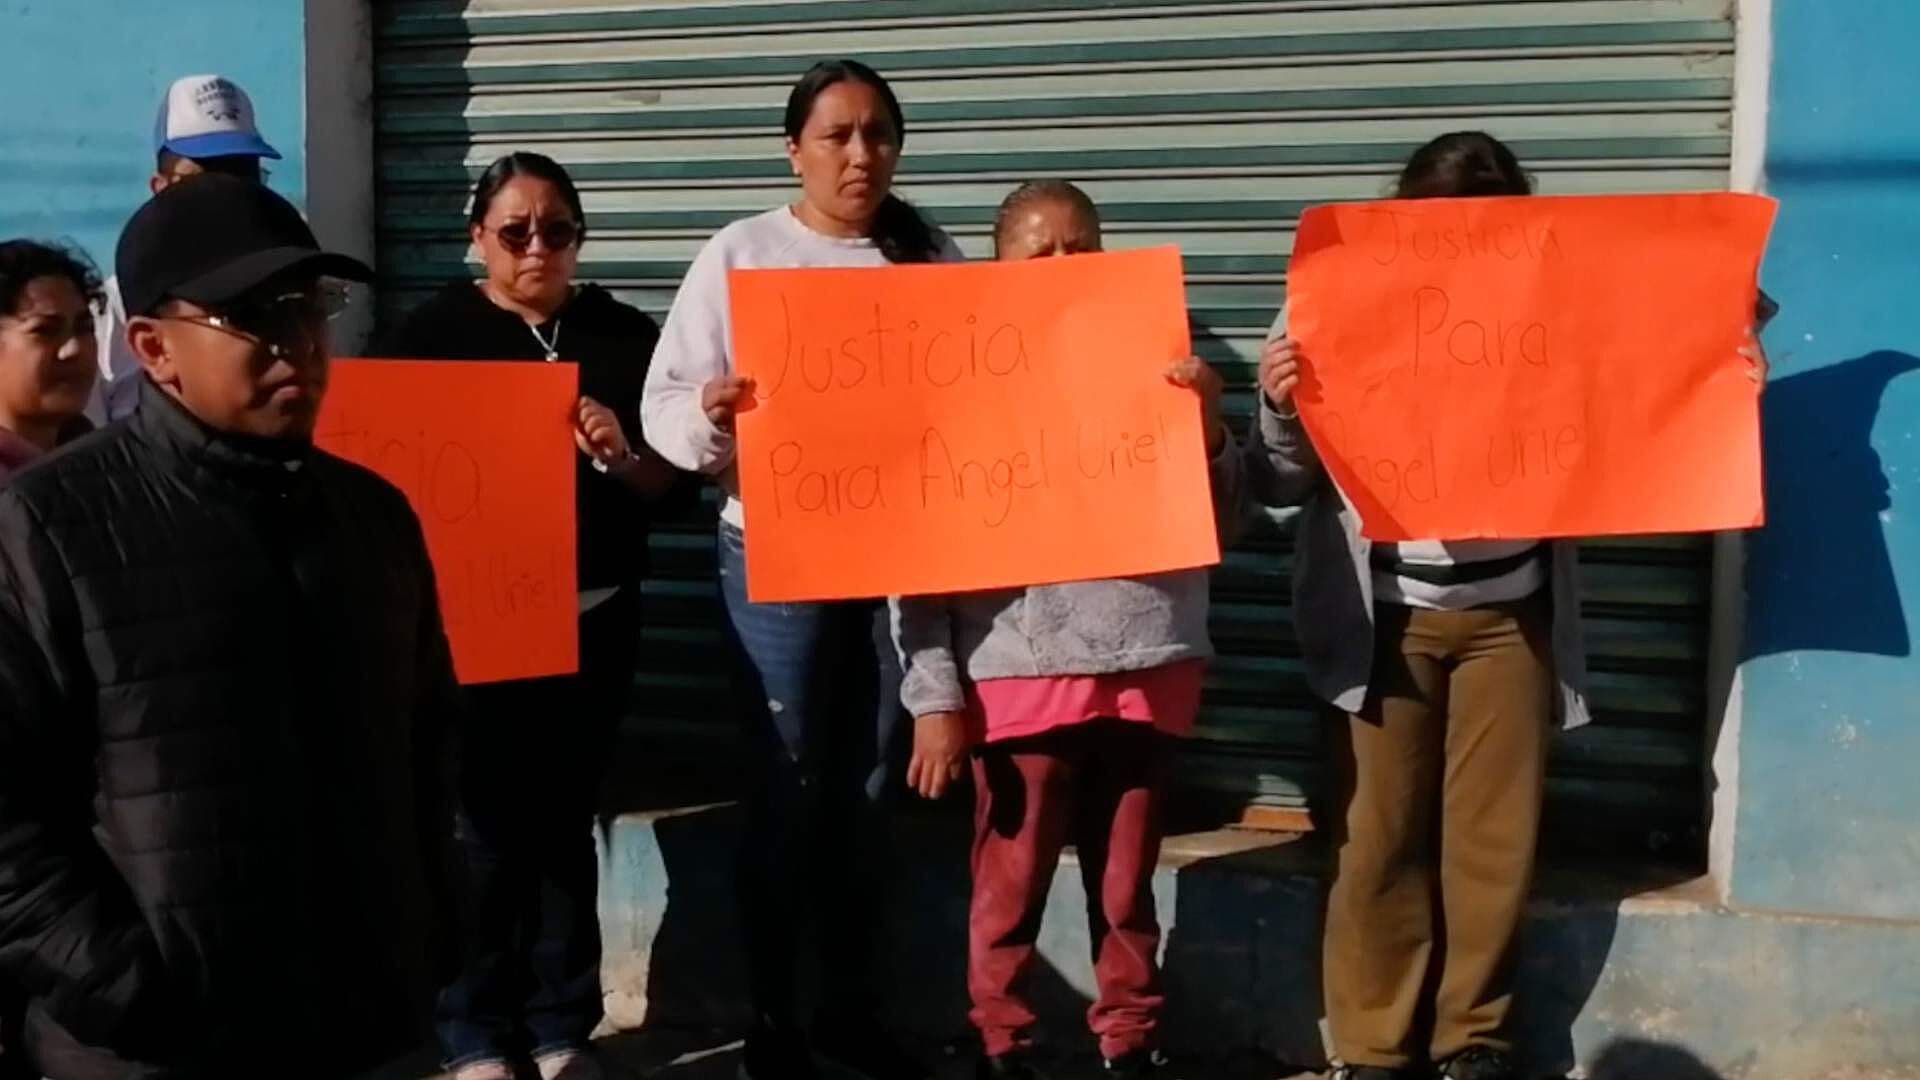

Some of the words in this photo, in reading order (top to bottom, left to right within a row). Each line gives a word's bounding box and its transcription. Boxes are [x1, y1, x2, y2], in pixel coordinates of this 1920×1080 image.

[753, 294, 1030, 400] Justicia
[1412, 285, 1549, 376] Para
[769, 441, 886, 518] Para
[919, 427, 1051, 528] Angel
[1078, 413, 1171, 480] Uriel
